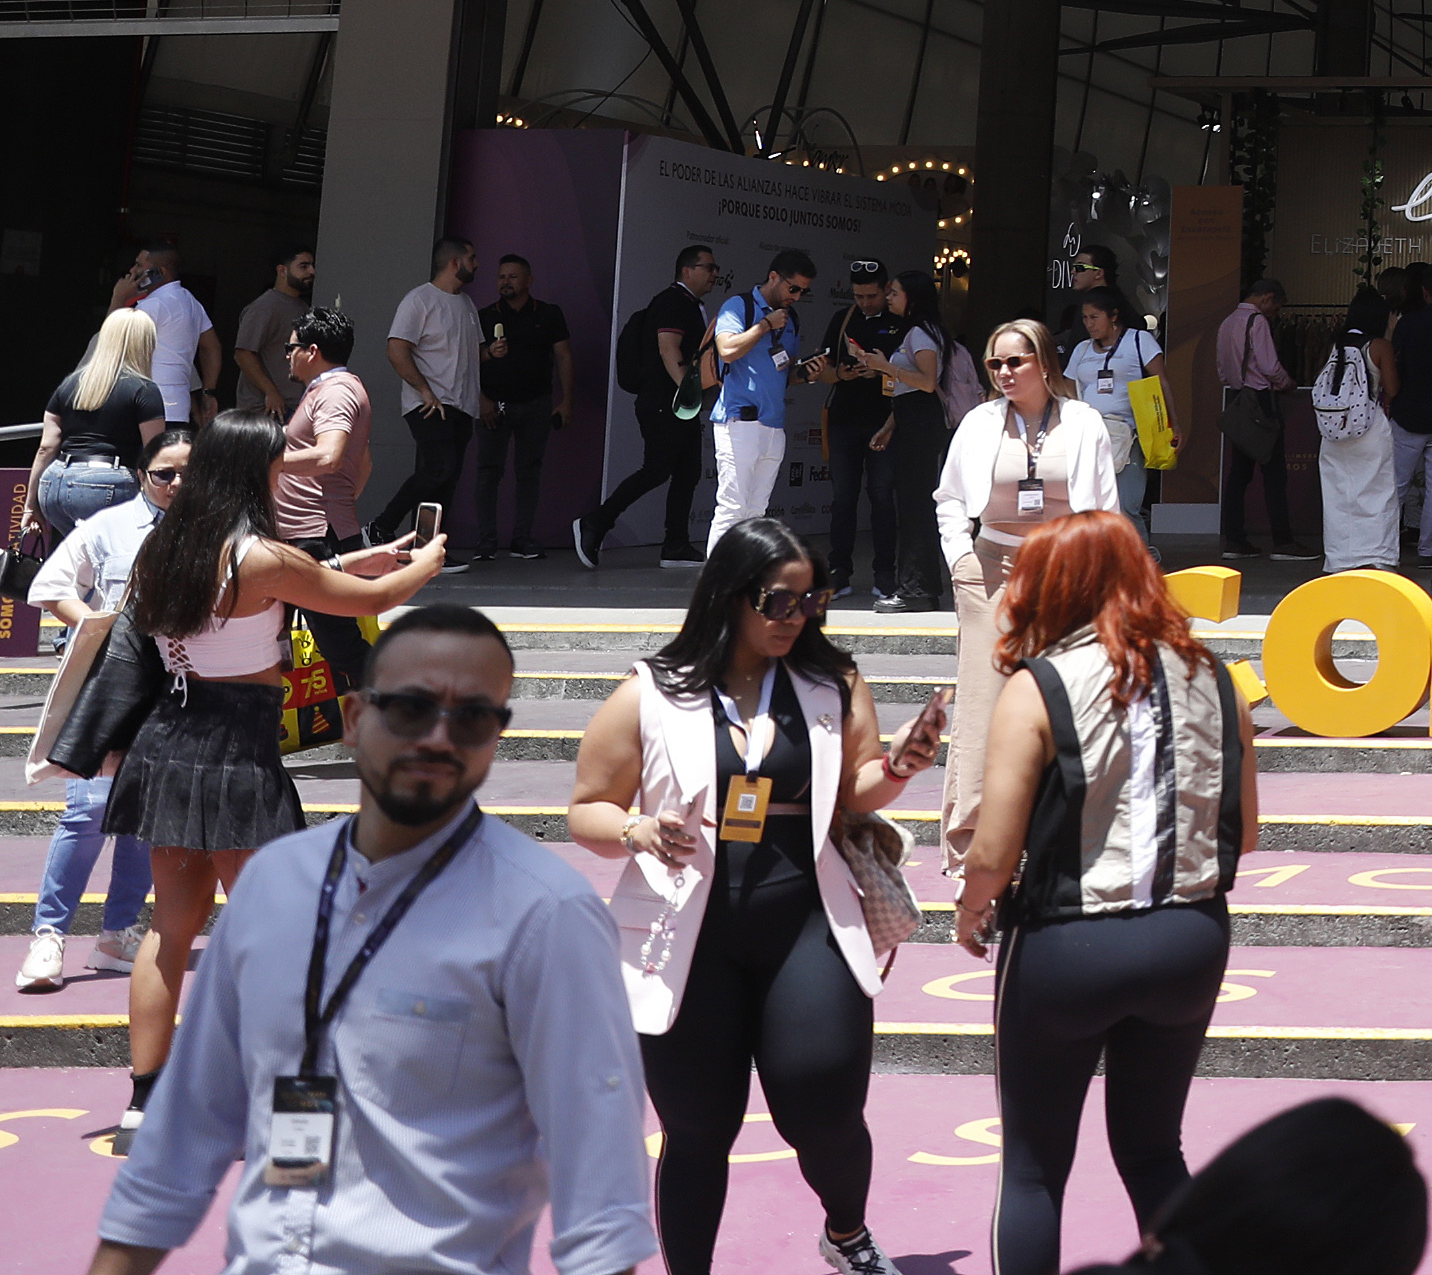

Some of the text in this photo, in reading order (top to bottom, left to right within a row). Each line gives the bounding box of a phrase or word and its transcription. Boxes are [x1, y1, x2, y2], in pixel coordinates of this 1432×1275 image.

[660, 160, 671, 178] EL
[672, 162, 702, 184] PODER
[704, 168, 717, 185] DE
[719, 170, 735, 188] LAS
[737, 173, 782, 196] ALIANZAS
[785, 181, 810, 201] HACE
[812, 186, 841, 205] VIBRAR
[763, 204, 788, 223] SOLO
[789, 207, 824, 228] JUNTOS
[826, 212, 861, 233] SOMOS!
[1310, 233, 1420, 254] ELIZAETH
[809, 466, 830, 481] FedE
[8, 483, 27, 551] ATIVIDAD
